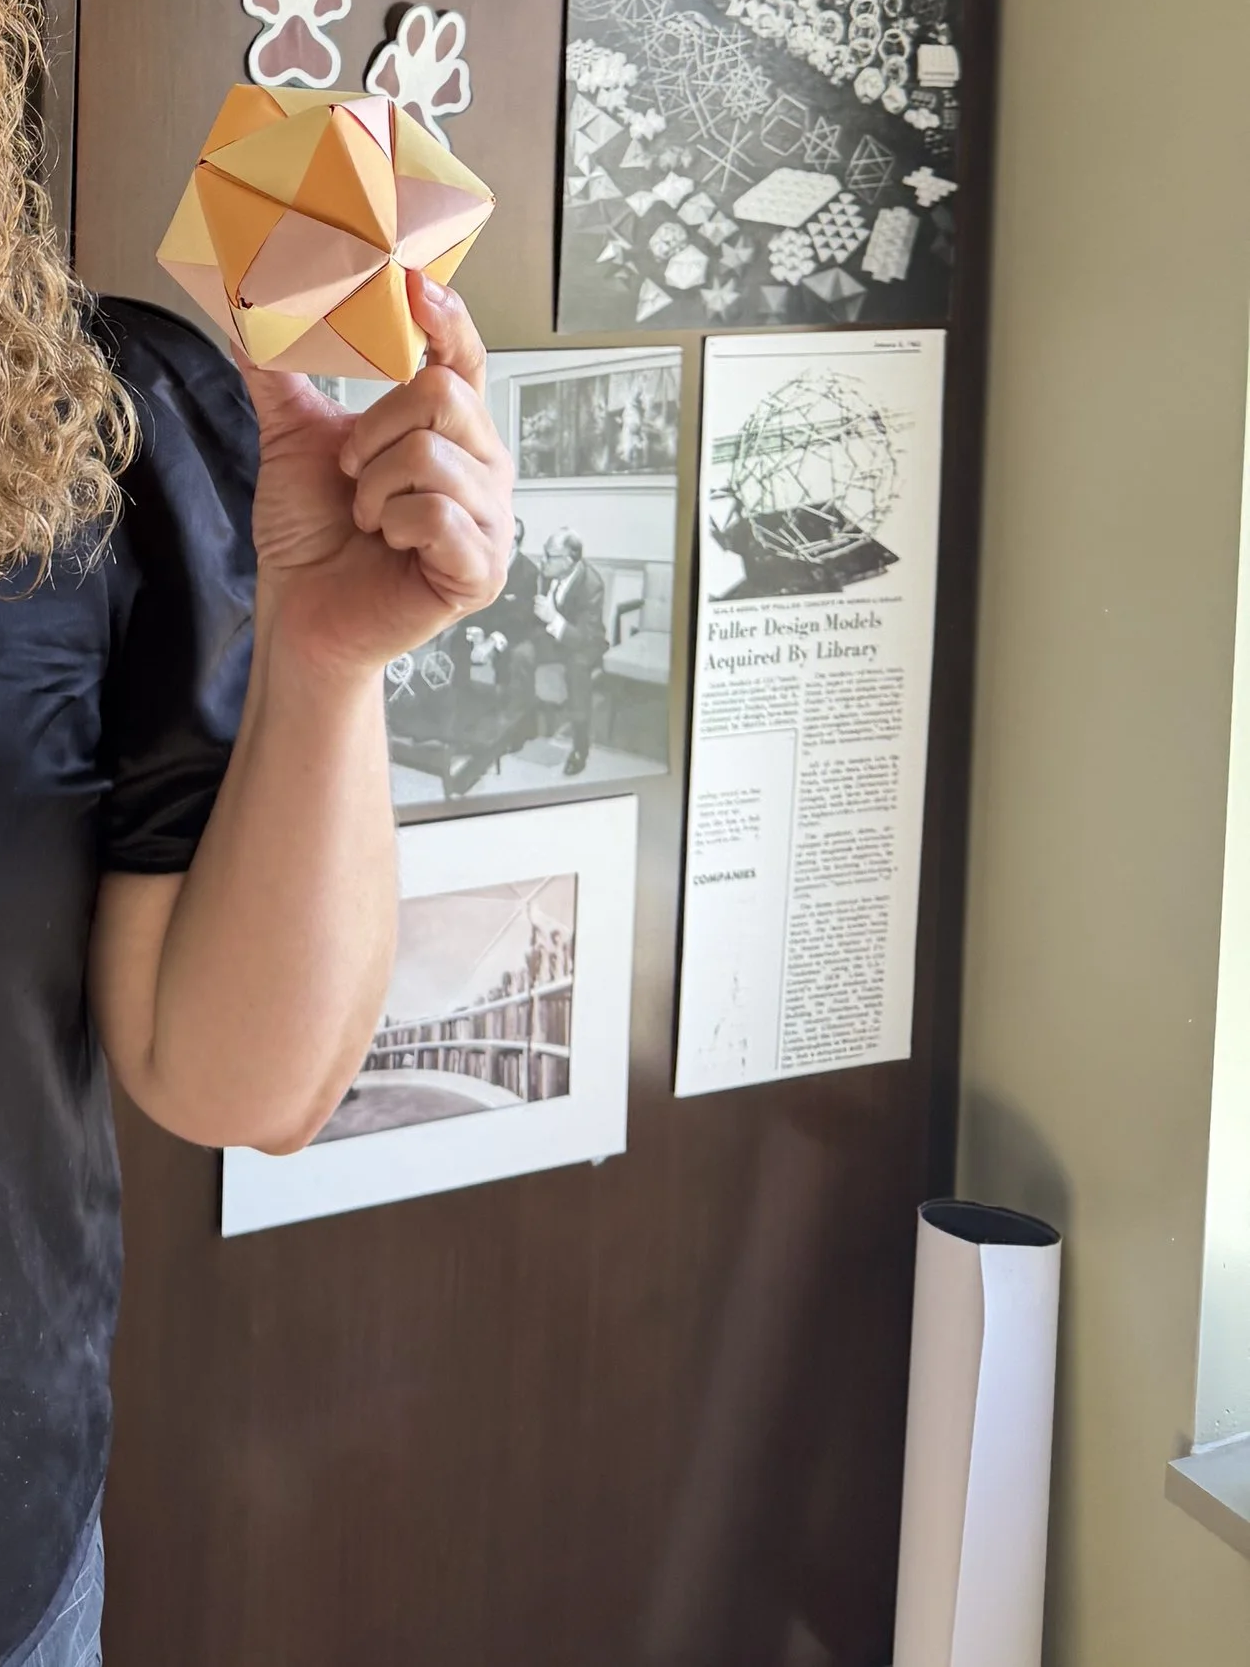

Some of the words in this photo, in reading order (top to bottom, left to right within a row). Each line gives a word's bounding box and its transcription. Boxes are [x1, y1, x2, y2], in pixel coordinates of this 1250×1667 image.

[707, 618, 757, 642] Fuller
[764, 617, 820, 640] Design
[824, 610, 883, 631] Models
[705, 645, 781, 675] Acquired
[788, 644, 809, 668] By
[816, 640, 879, 662] Library
[692, 868, 757, 887] COMPANIES
